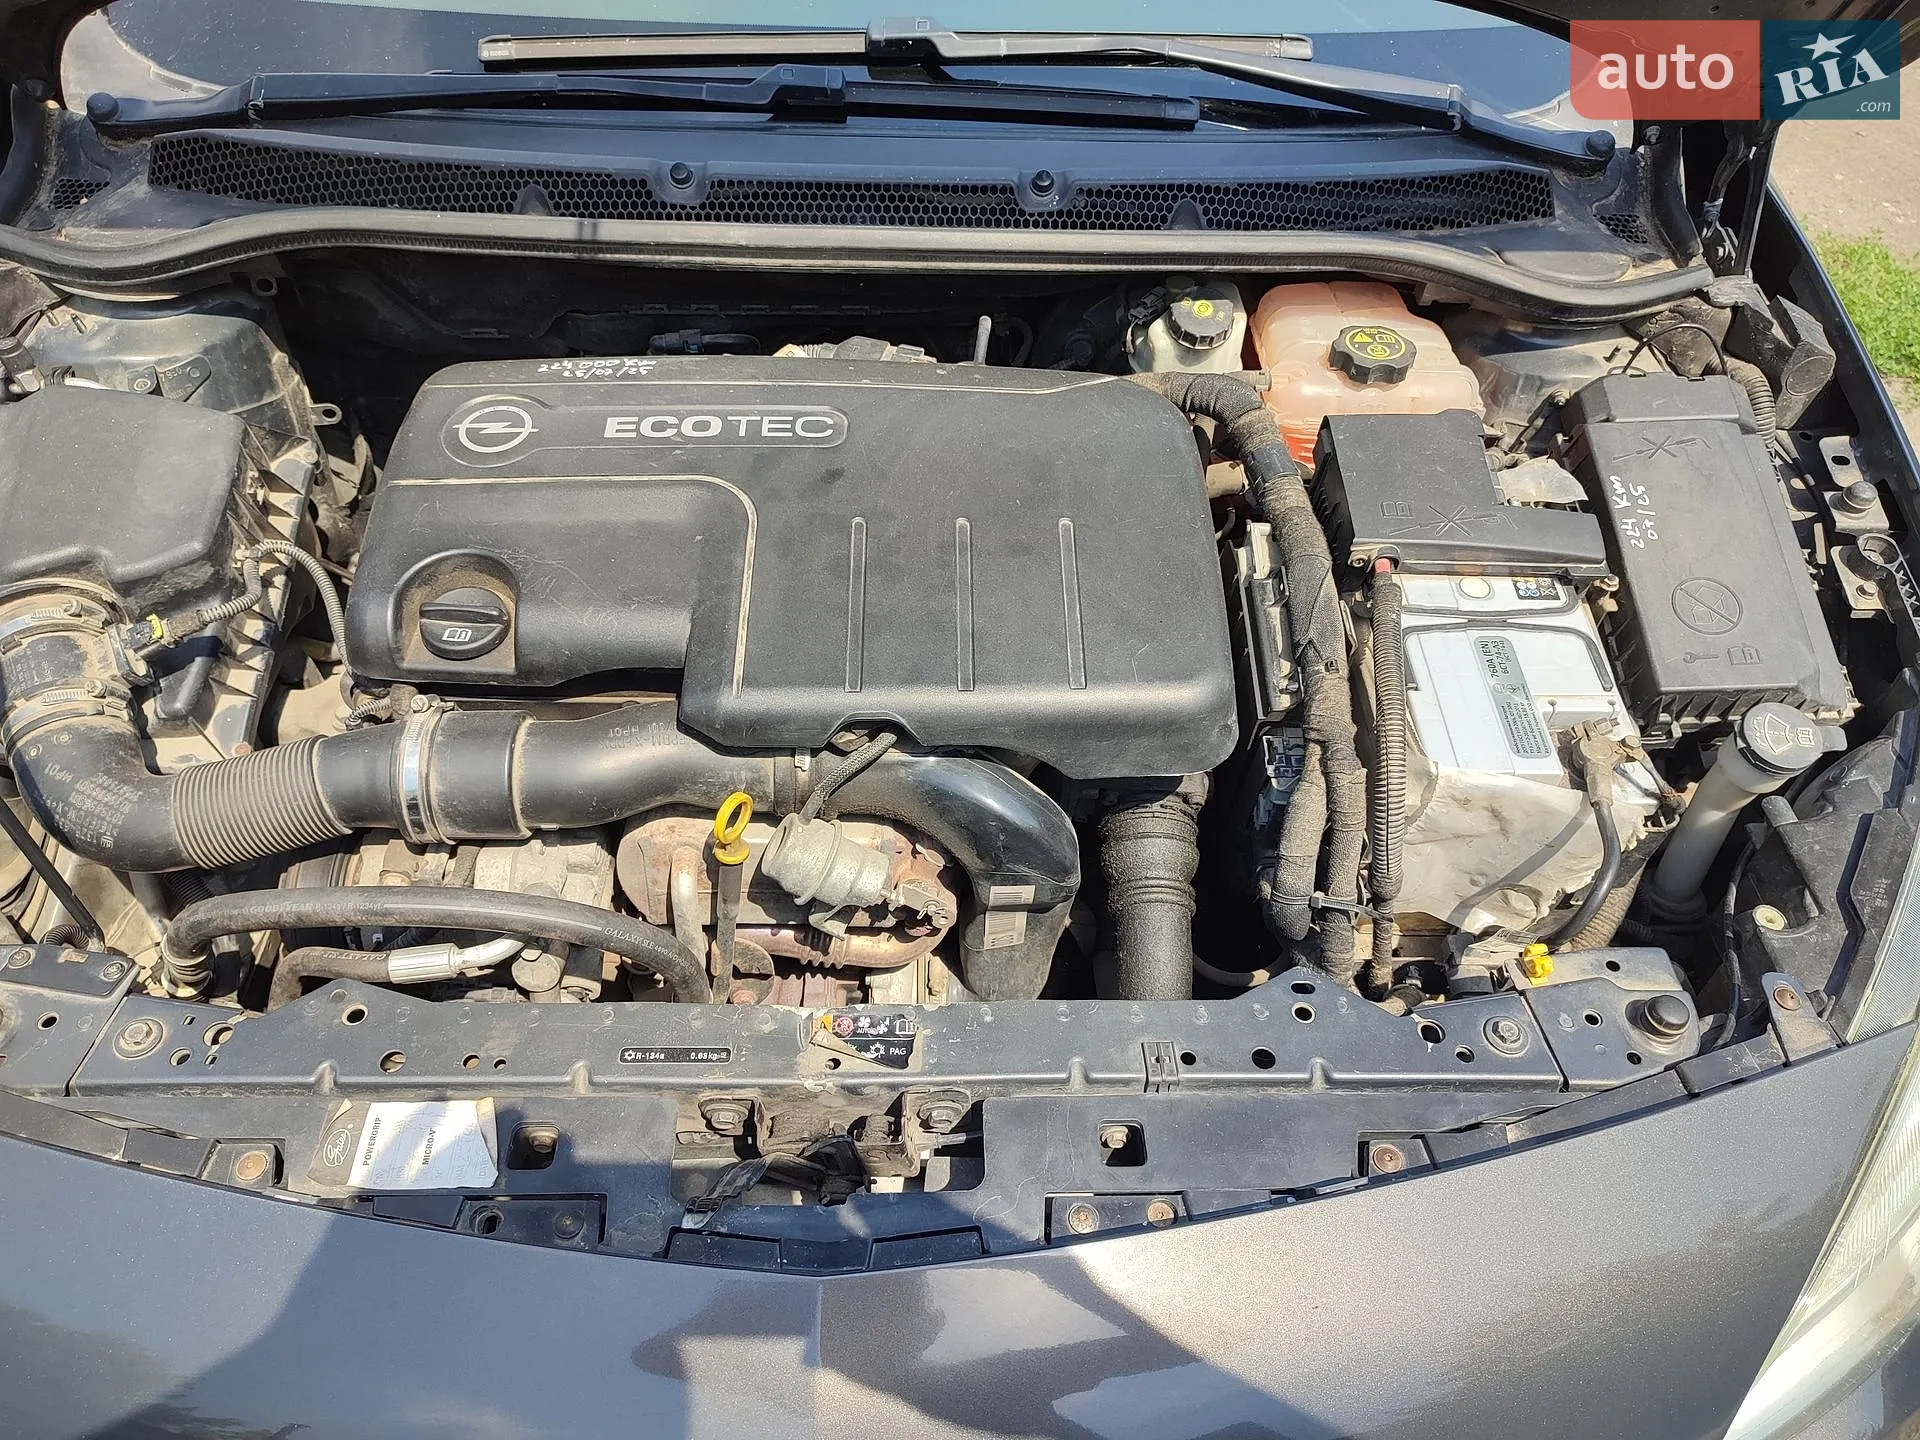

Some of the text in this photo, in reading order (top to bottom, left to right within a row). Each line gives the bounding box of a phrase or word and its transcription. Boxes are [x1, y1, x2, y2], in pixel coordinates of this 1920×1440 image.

[537, 360, 573, 373] 224
[578, 359, 620, 369] 000
[603, 415, 835, 439] ECOTEC
[1486, 658, 1500, 679] 760A
[604, 927, 642, 945] GALAXY
[635, 1051, 665, 1060] R-134a
[889, 1047, 907, 1055] PAG
[326, 1130, 348, 1167] Gates
[362, 1116, 383, 1167] POWERGRIP
[421, 1127, 437, 1166] MICRO-V
